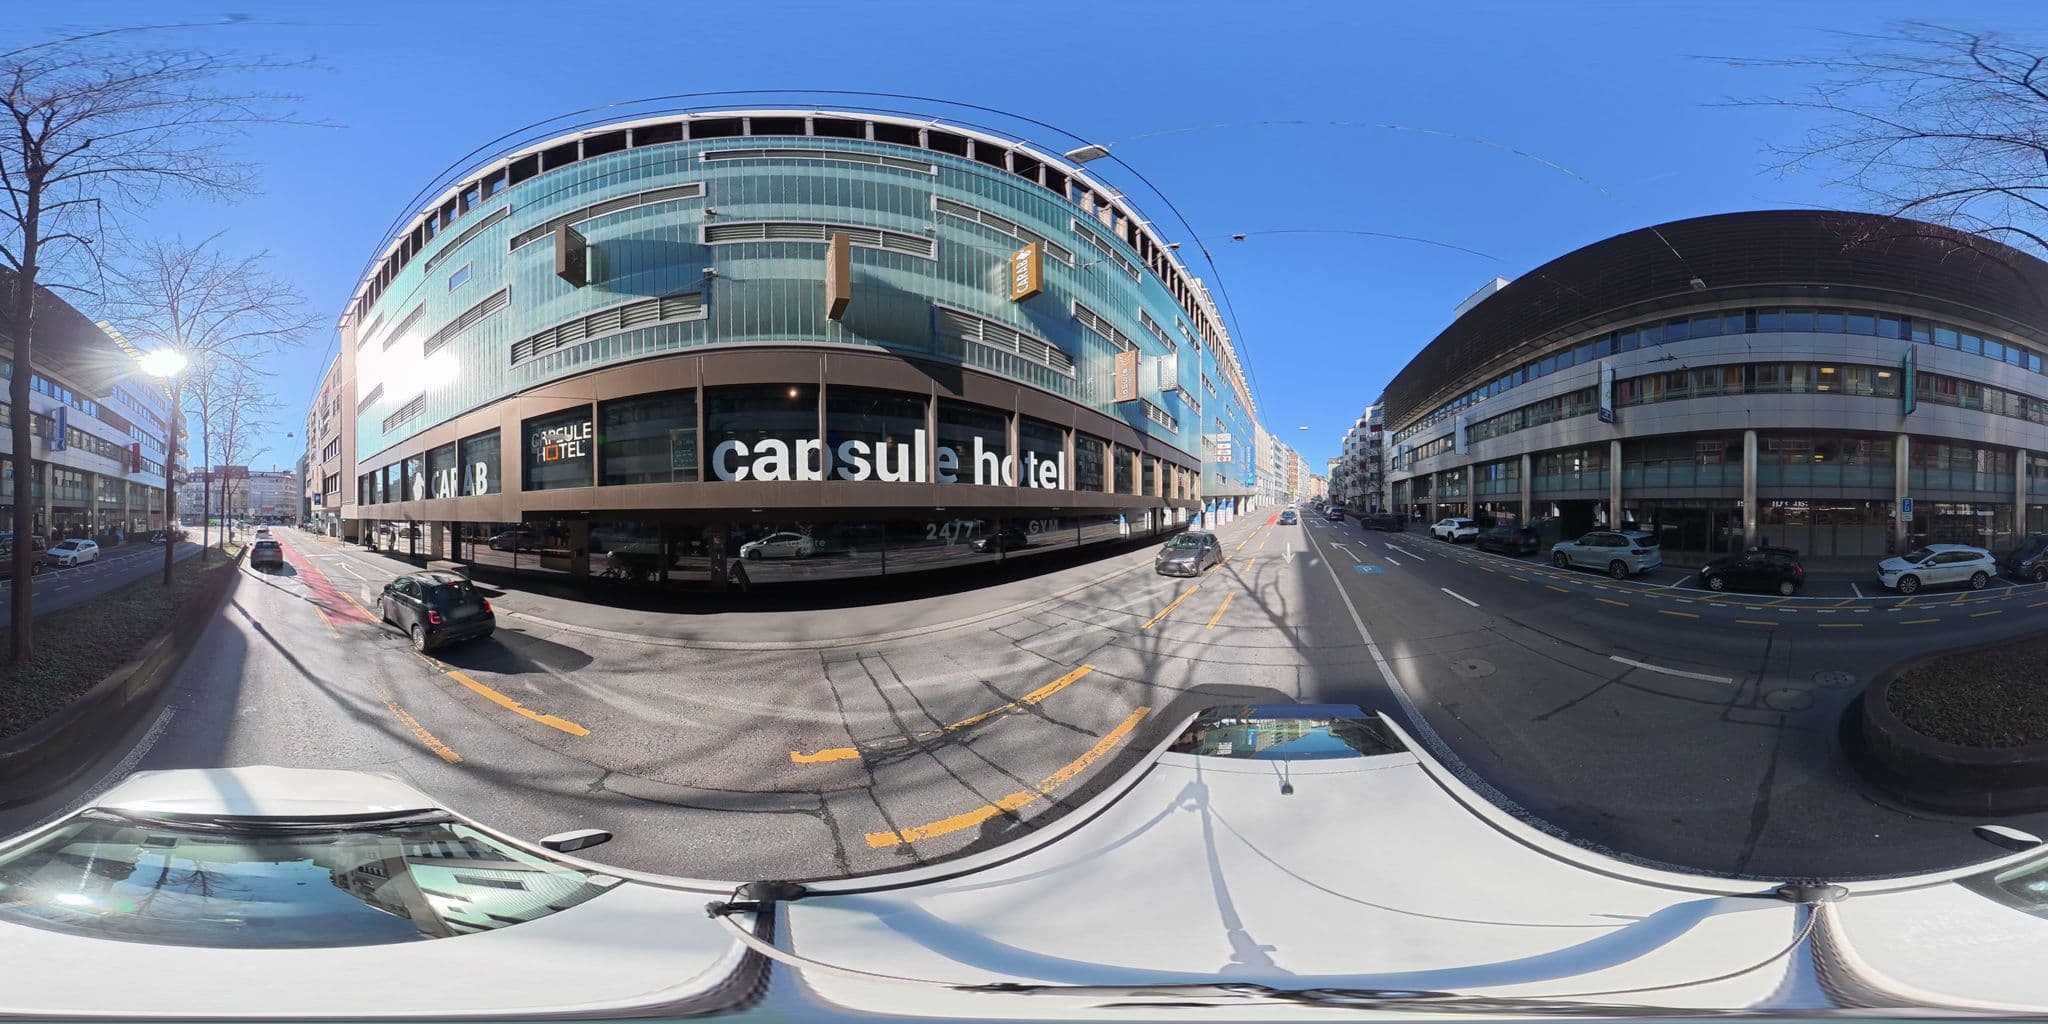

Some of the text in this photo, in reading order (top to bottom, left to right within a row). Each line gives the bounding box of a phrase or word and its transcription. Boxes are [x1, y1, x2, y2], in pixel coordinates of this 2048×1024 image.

[1015, 258, 1029, 294] CARAB
[531, 421, 592, 449] CAPSULE
[536, 440, 586, 463] HOTEL
[712, 429, 959, 485] capsule
[974, 436, 1066, 491] hotel
[1028, 519, 1059, 534] GYM
